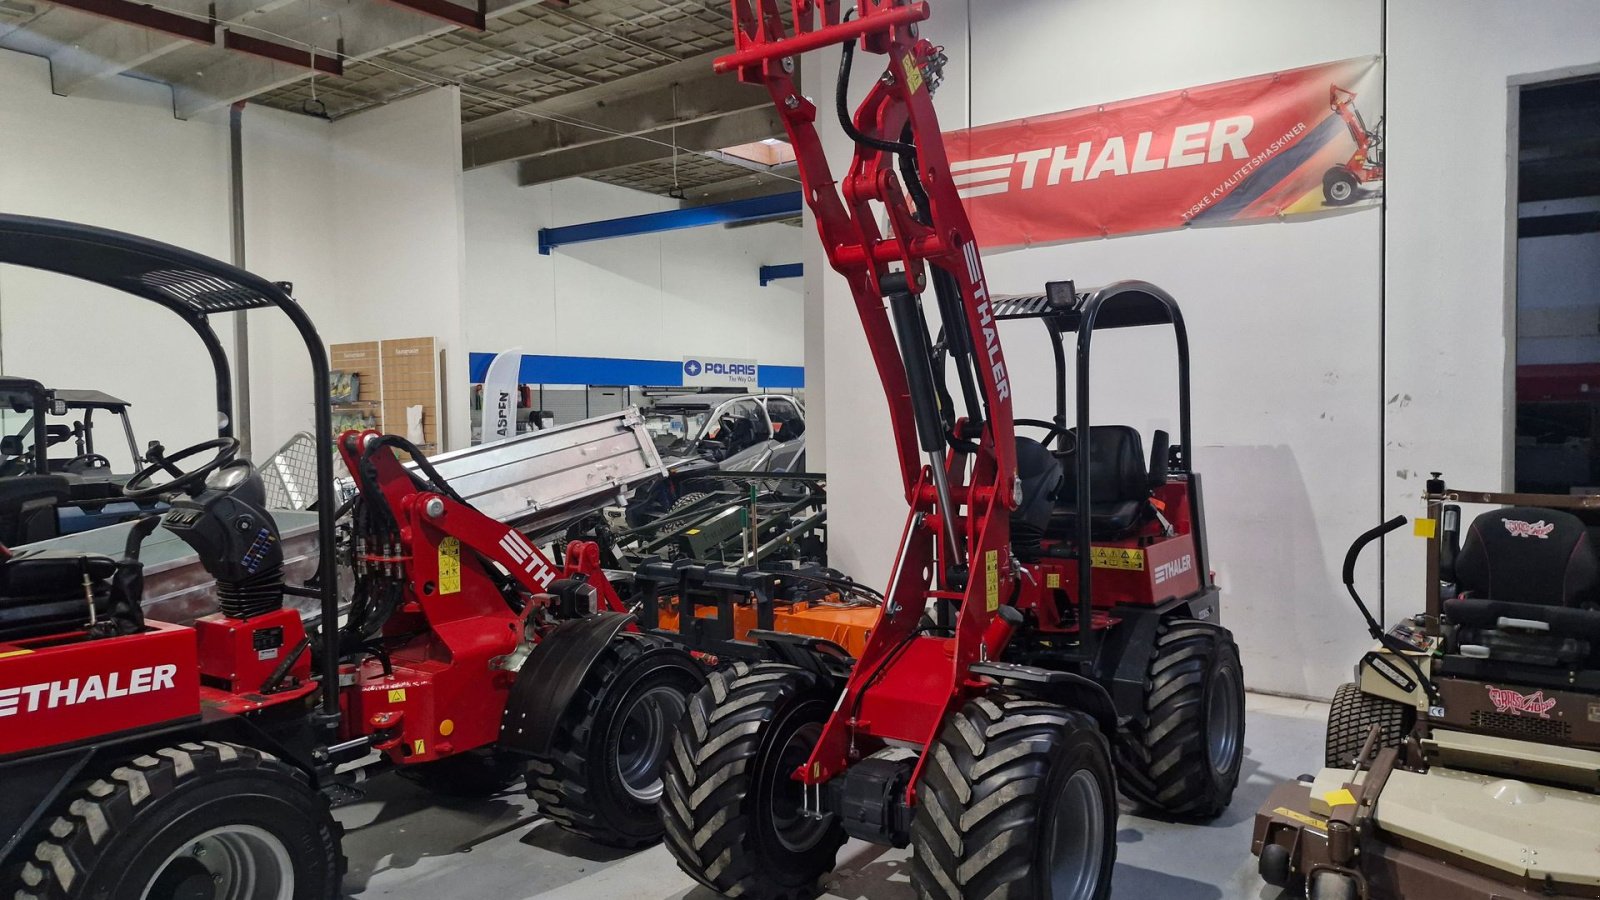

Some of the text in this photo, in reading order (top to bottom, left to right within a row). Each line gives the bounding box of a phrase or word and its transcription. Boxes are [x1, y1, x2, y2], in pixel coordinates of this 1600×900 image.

[1181, 122, 1307, 219] TYSKE KVALITETSMASKINER
[704, 363, 756, 375] POLARIS
[496, 392, 509, 436] ASPEN
